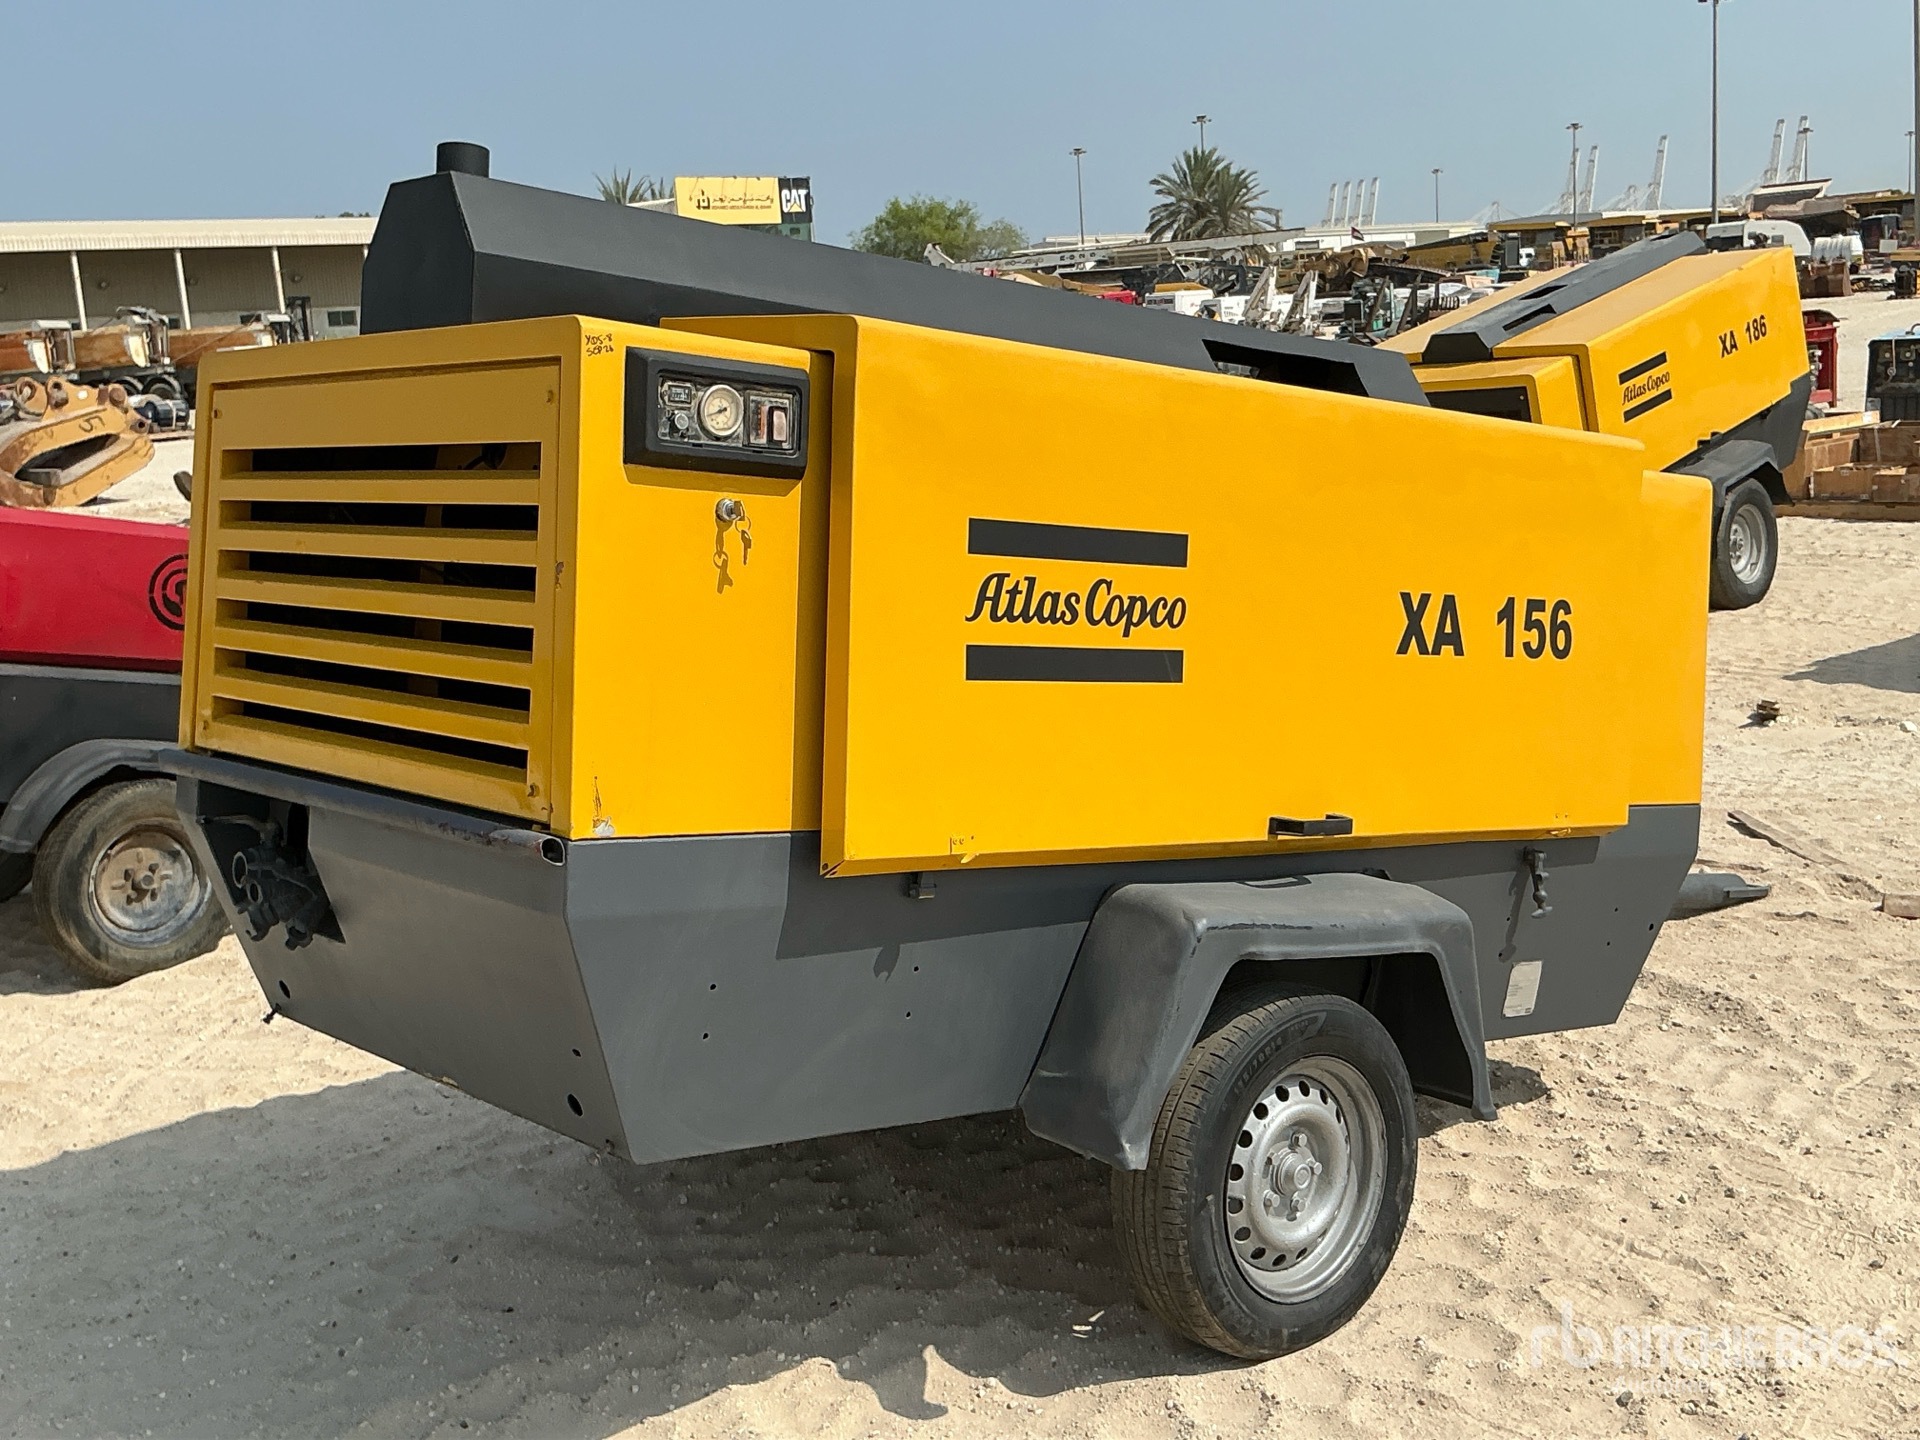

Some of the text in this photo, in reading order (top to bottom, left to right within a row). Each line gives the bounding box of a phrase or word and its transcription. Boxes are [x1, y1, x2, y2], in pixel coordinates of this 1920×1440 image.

[781, 189, 809, 213] CAT
[1718, 314, 1768, 359] XA 186
[1622, 371, 1670, 405] Atlas Copco
[965, 573, 1187, 638] Atlas Copco
[1396, 591, 1573, 660] XA 156
